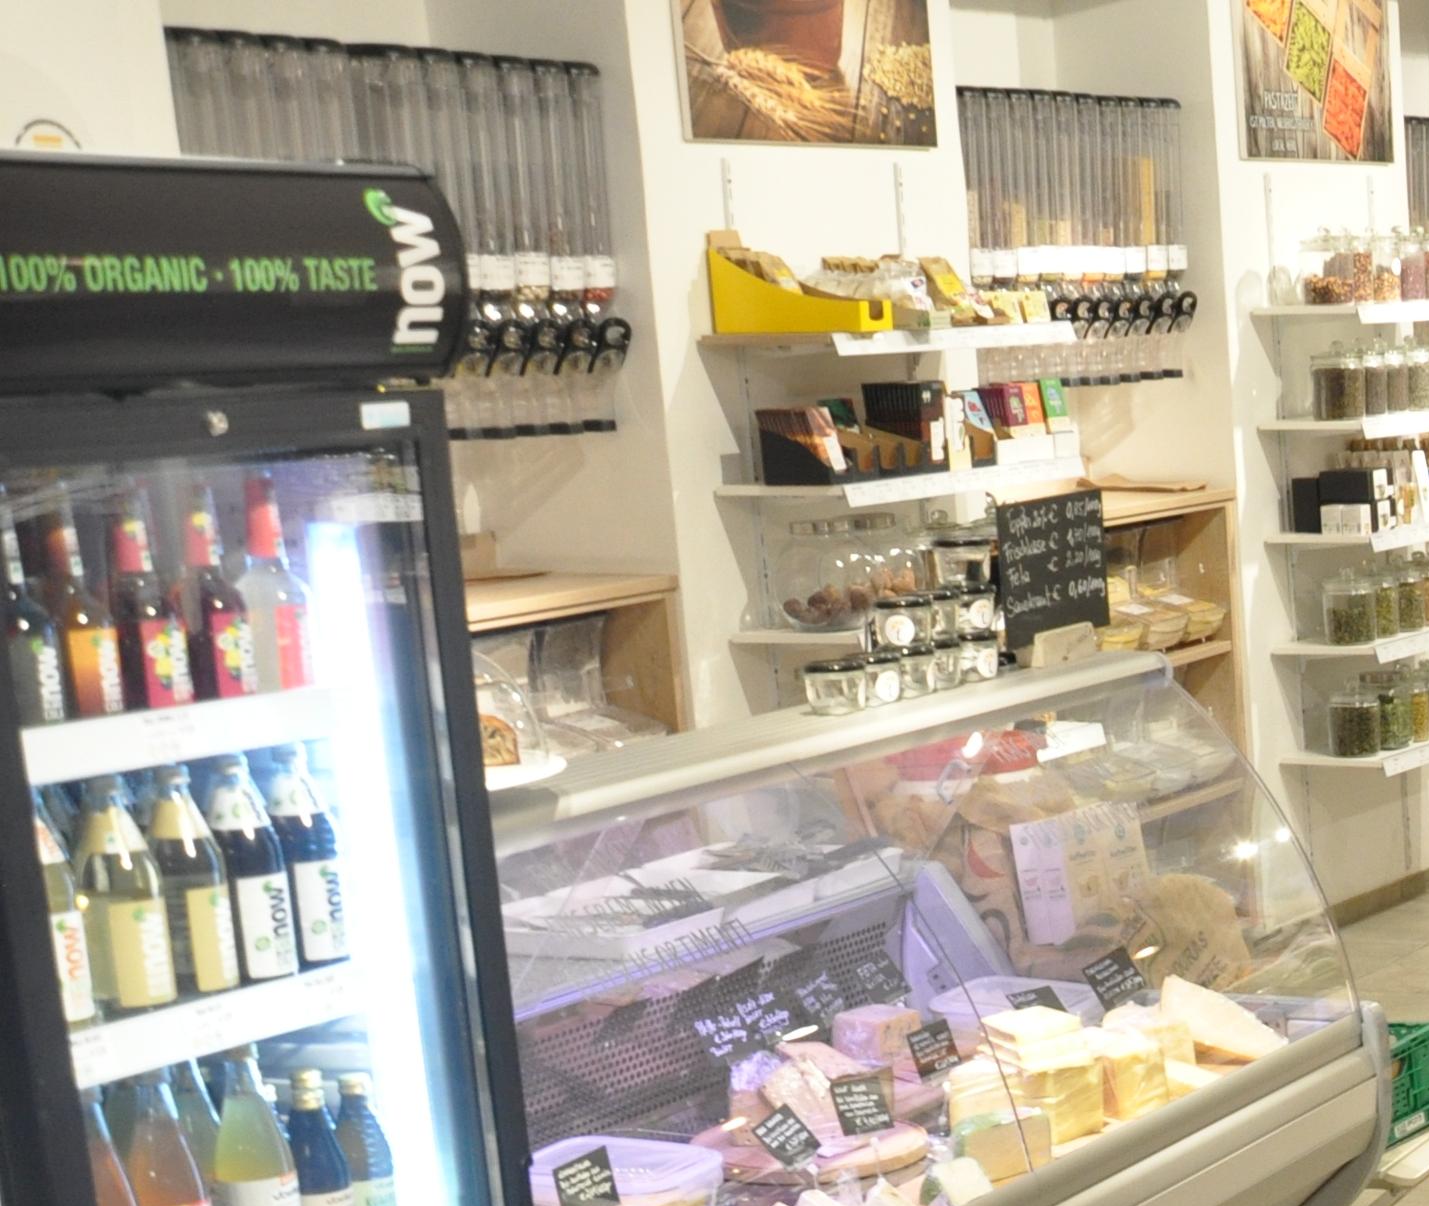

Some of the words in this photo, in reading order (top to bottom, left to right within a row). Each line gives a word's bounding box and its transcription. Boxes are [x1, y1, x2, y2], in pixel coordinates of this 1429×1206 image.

[0, 256, 76, 292] 100%
[84, 257, 207, 292] ORGANIC
[229, 258, 299, 292] 100%
[302, 258, 377, 292] TASTE
[392, 206, 445, 345] now
[270, 887, 288, 939] now
